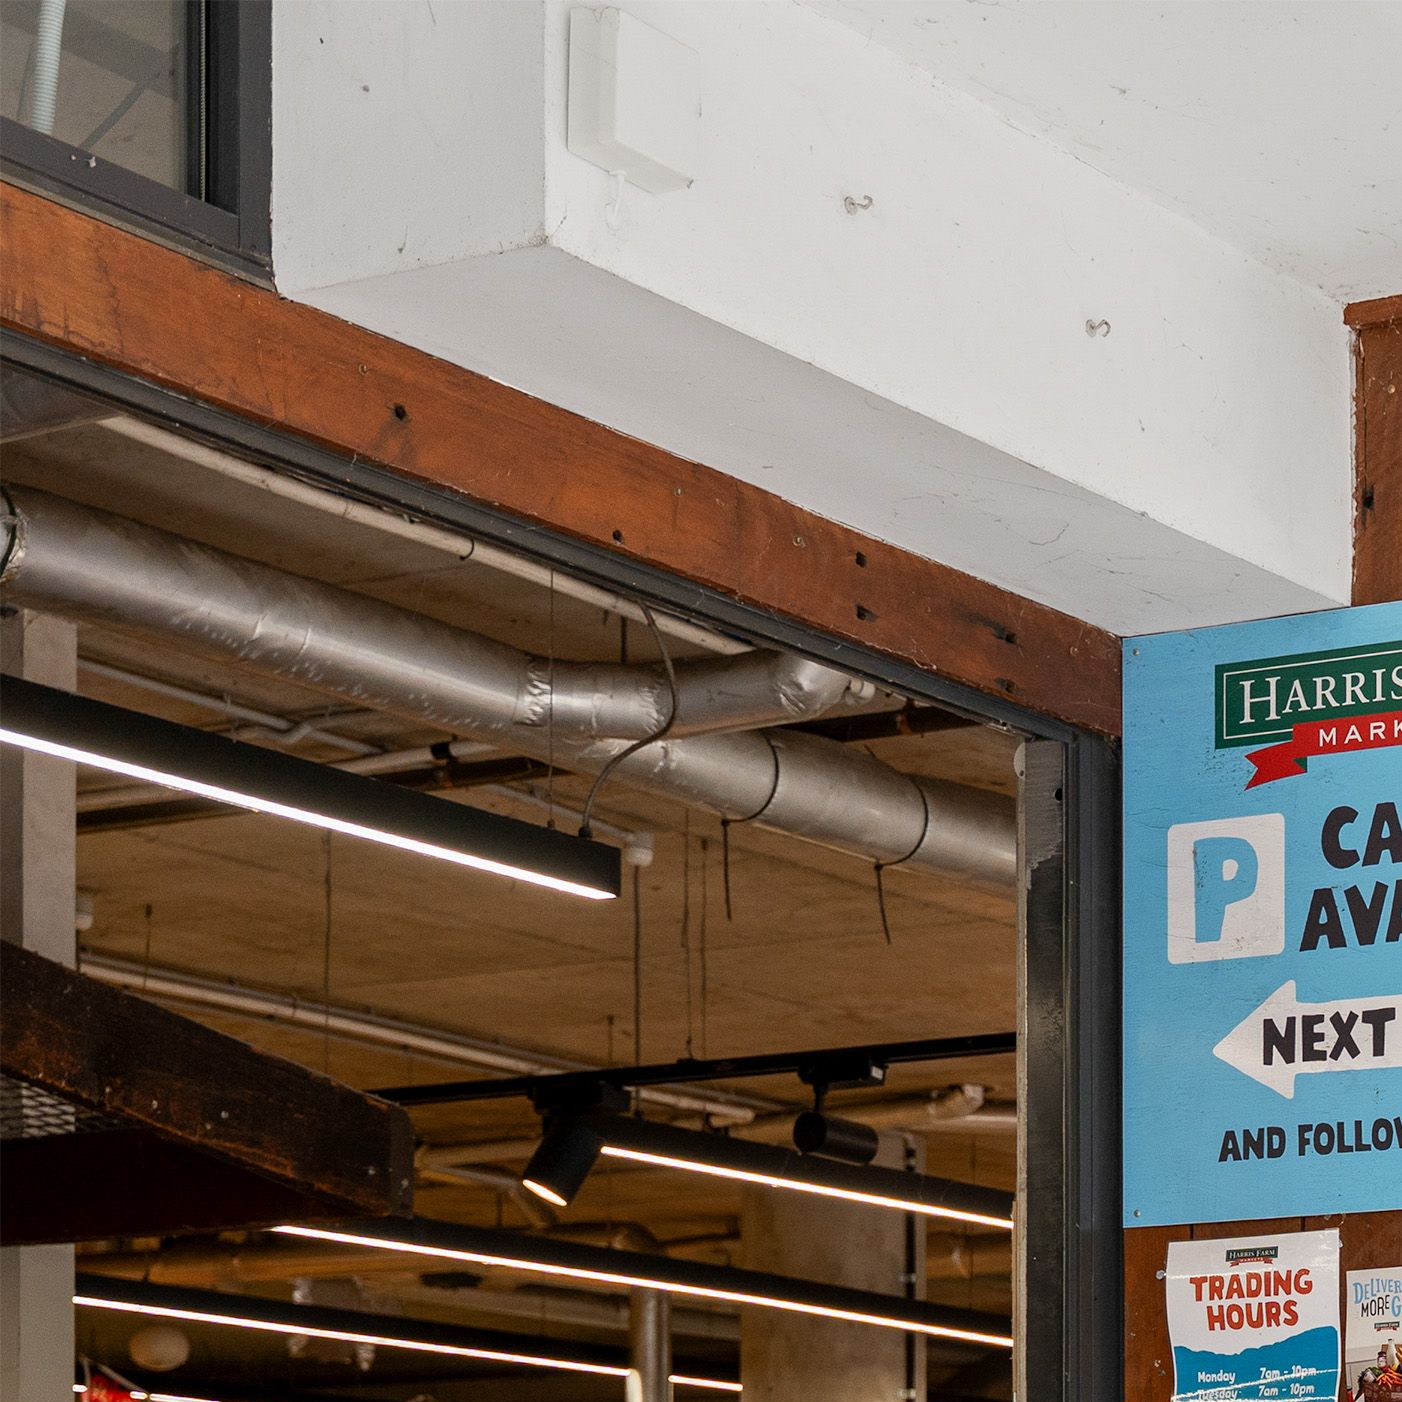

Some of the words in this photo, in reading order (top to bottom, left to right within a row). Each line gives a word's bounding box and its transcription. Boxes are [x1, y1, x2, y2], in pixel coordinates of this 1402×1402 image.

[1192, 837, 1259, 943] P
[1263, 1006, 1395, 1065] NEXT
[1219, 1126, 1286, 1162] AND
[1190, 1268, 1312, 1302] TRADING
[1206, 1300, 1299, 1331] HOURS
[1361, 1295, 1390, 1317] MORE
[1198, 1371, 1235, 1384] Monday
[1260, 1367, 1280, 1380] 7am
[1258, 1385, 1278, 1396] 7am
[1291, 1384, 1315, 1395] 10pm
